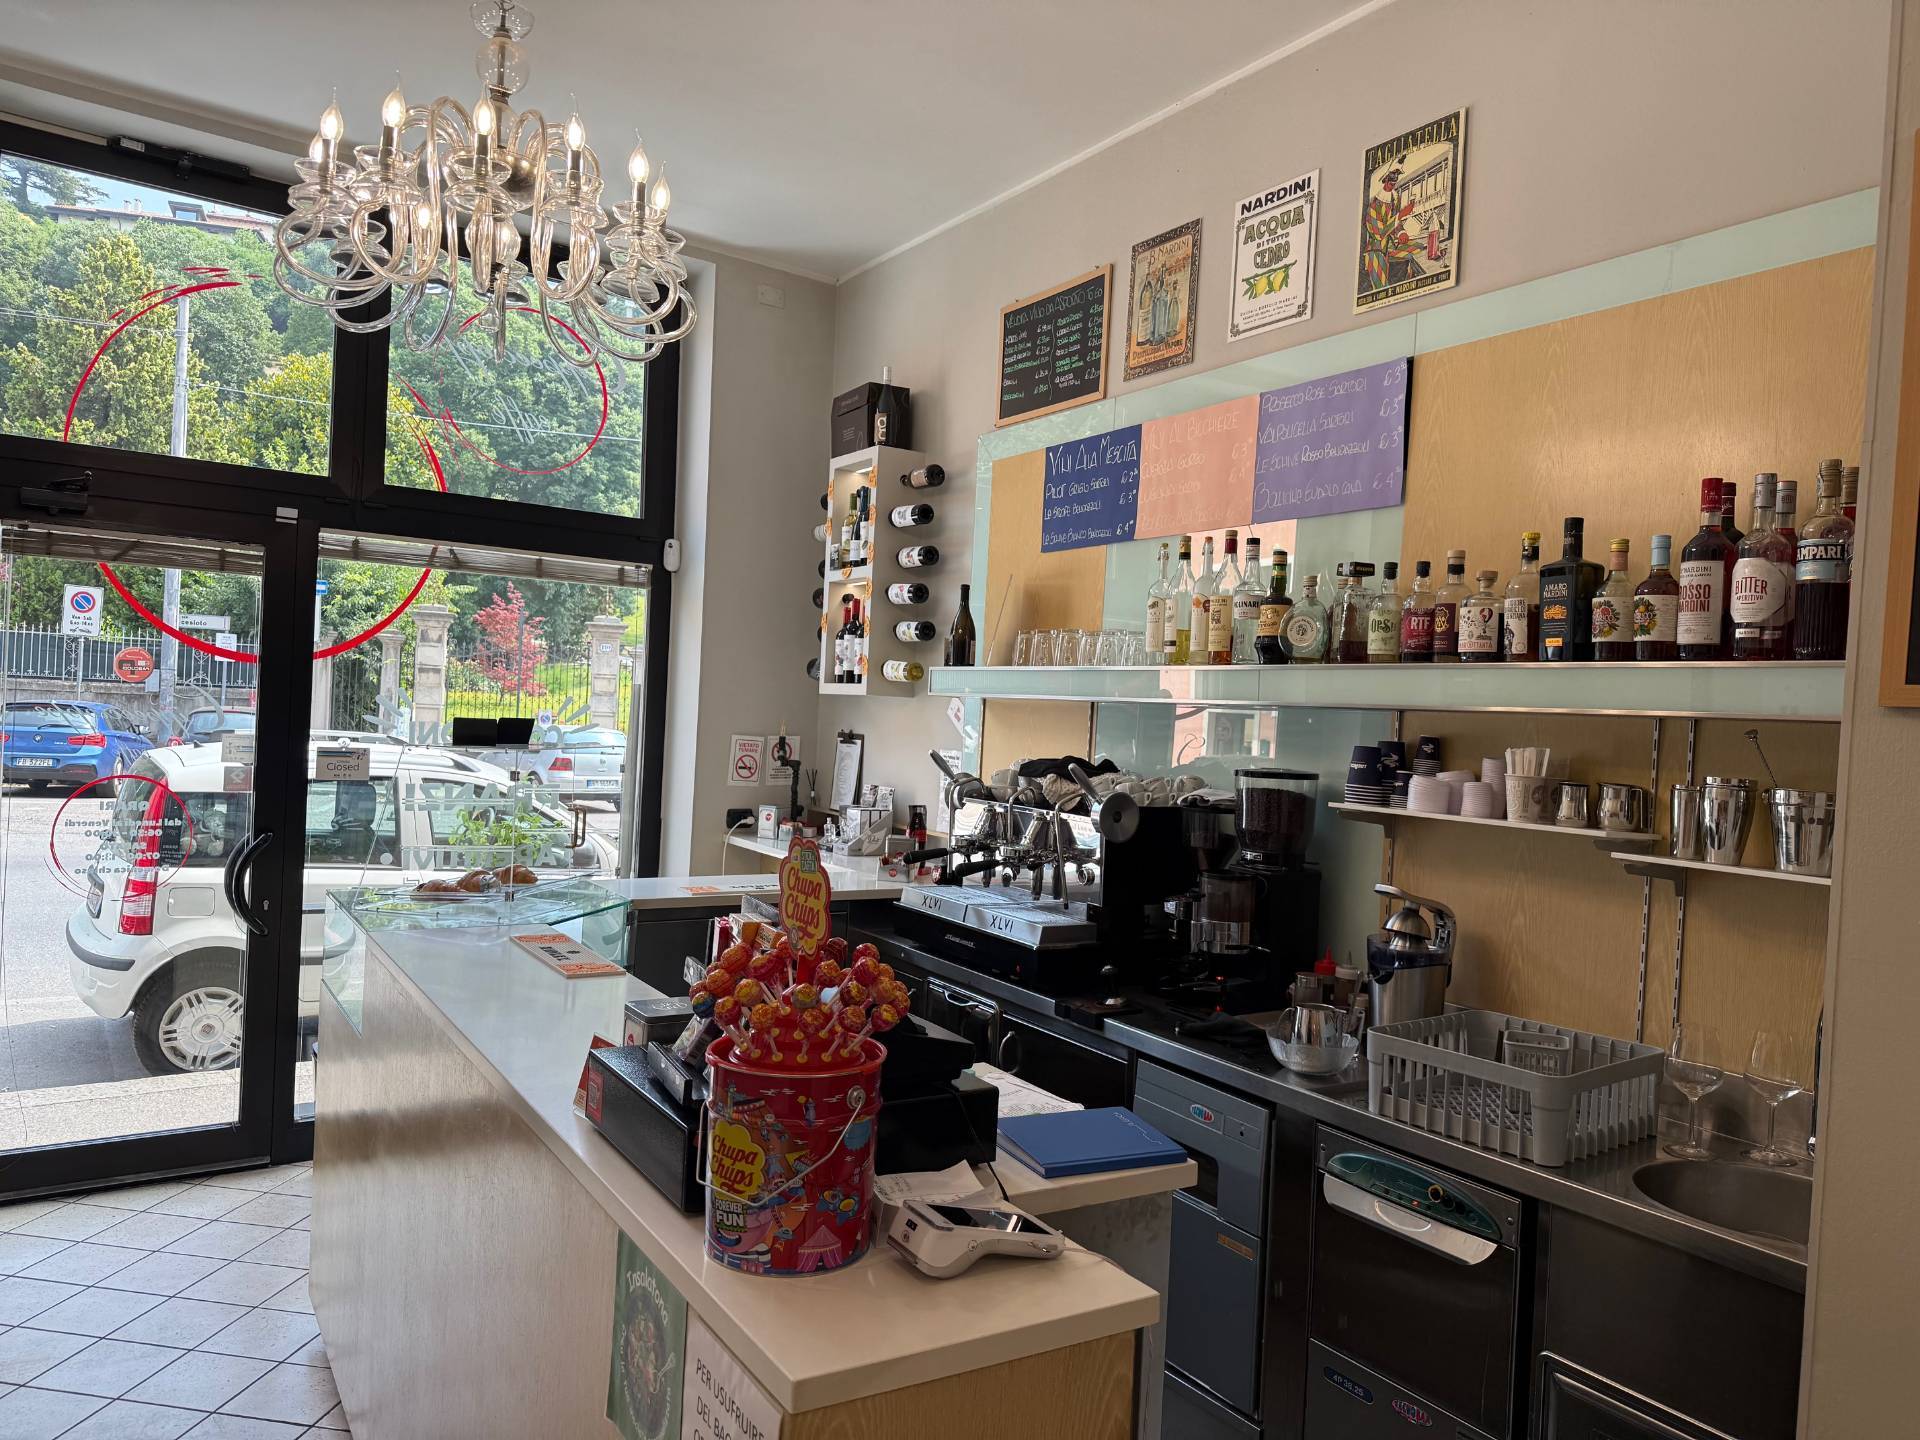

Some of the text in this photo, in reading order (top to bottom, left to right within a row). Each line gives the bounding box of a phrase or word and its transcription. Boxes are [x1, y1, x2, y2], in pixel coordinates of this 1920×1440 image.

[1368, 116, 1458, 170] TAGLIATELLA
[1241, 176, 1311, 216] NARDINI
[1243, 205, 1305, 245] ACQUA
[1158, 237, 1190, 260] NARDINI
[1265, 232, 1290, 246] TUTTO
[1254, 241, 1290, 269] CEDRO
[1049, 446, 1071, 476] VINI
[1796, 545, 1843, 562] AMPARI
[1543, 590, 1568, 599] NARDINI
[1544, 583, 1568, 592] AMARO
[1735, 576, 1768, 596] BITTER
[1410, 617, 1431, 630] RTF
[326, 762, 360, 771] Closed
[787, 866, 822, 903] Chupa
[785, 893, 820, 930] Chups
[921, 895, 942, 910] XLVI
[989, 914, 1014, 933] XLVI
[712, 1134, 759, 1165] Chupa
[711, 1154, 754, 1187] Chups
[715, 1200, 743, 1213] FOREVER
[716, 1212, 745, 1227] FUN
[626, 1264, 668, 1327] Insalatona
[695, 1358, 712, 1391] PER
[696, 1395, 712, 1429] DEL
